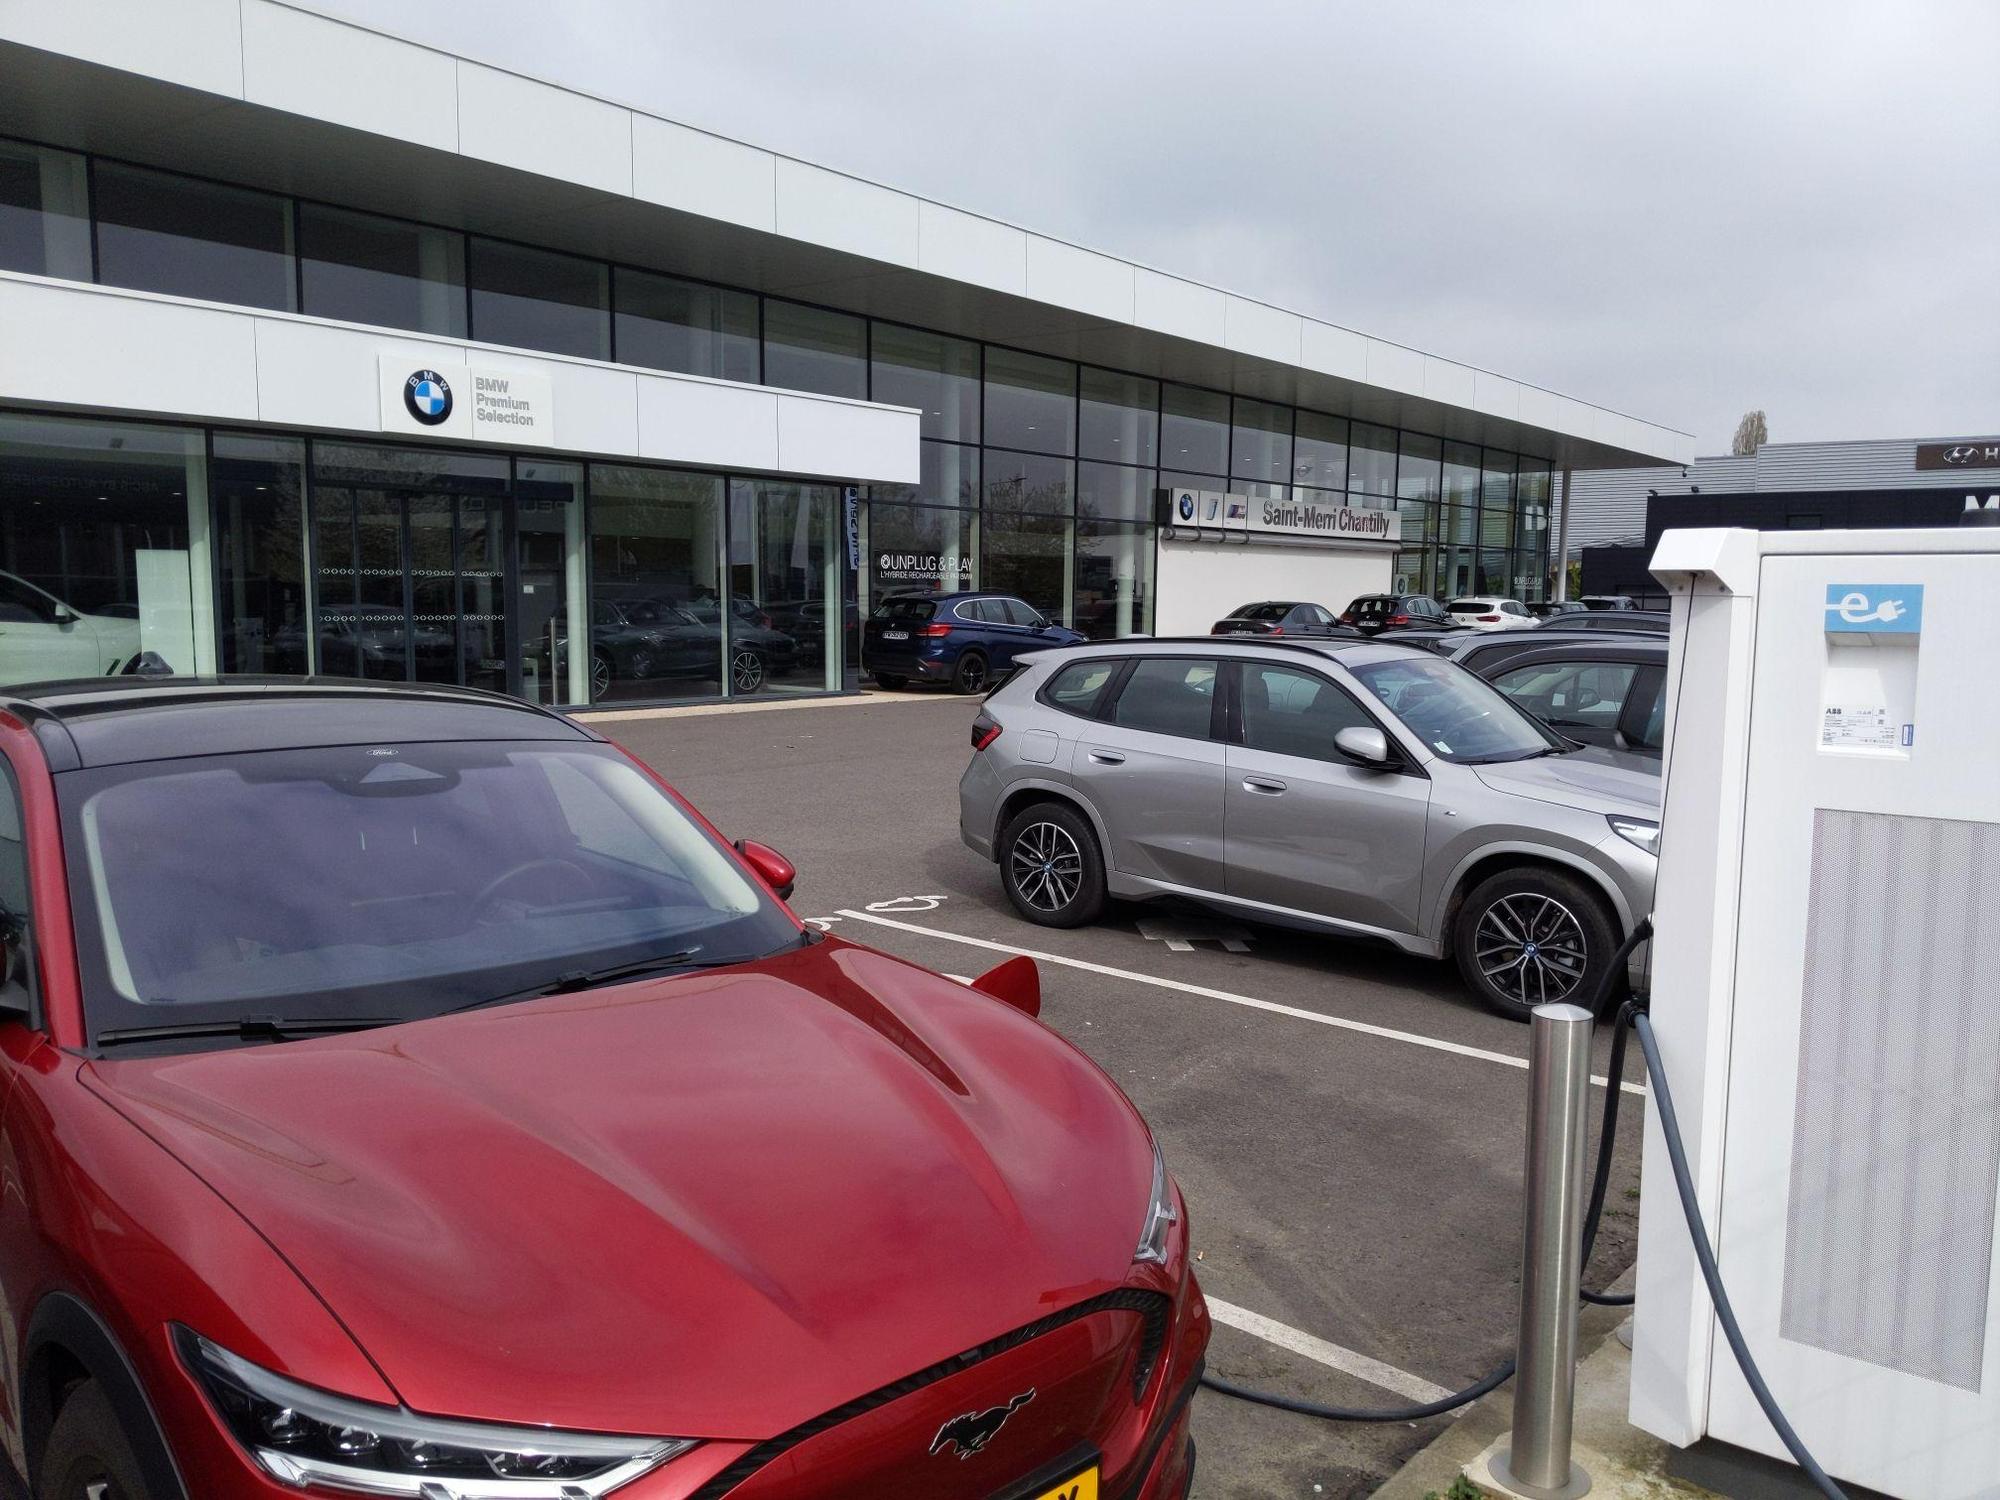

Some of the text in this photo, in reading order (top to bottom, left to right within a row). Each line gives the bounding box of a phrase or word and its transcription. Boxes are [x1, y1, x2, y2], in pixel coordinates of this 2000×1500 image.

[409, 370, 449, 391] BMW
[475, 376, 509, 393] BMW
[476, 392, 530, 411] Premium
[477, 408, 534, 427] Selection
[1263, 499, 1390, 538] Saint-Merri Chantilly
[891, 554, 974, 572] UNPLUG & PLAY
[1825, 707, 1843, 715] ABB
